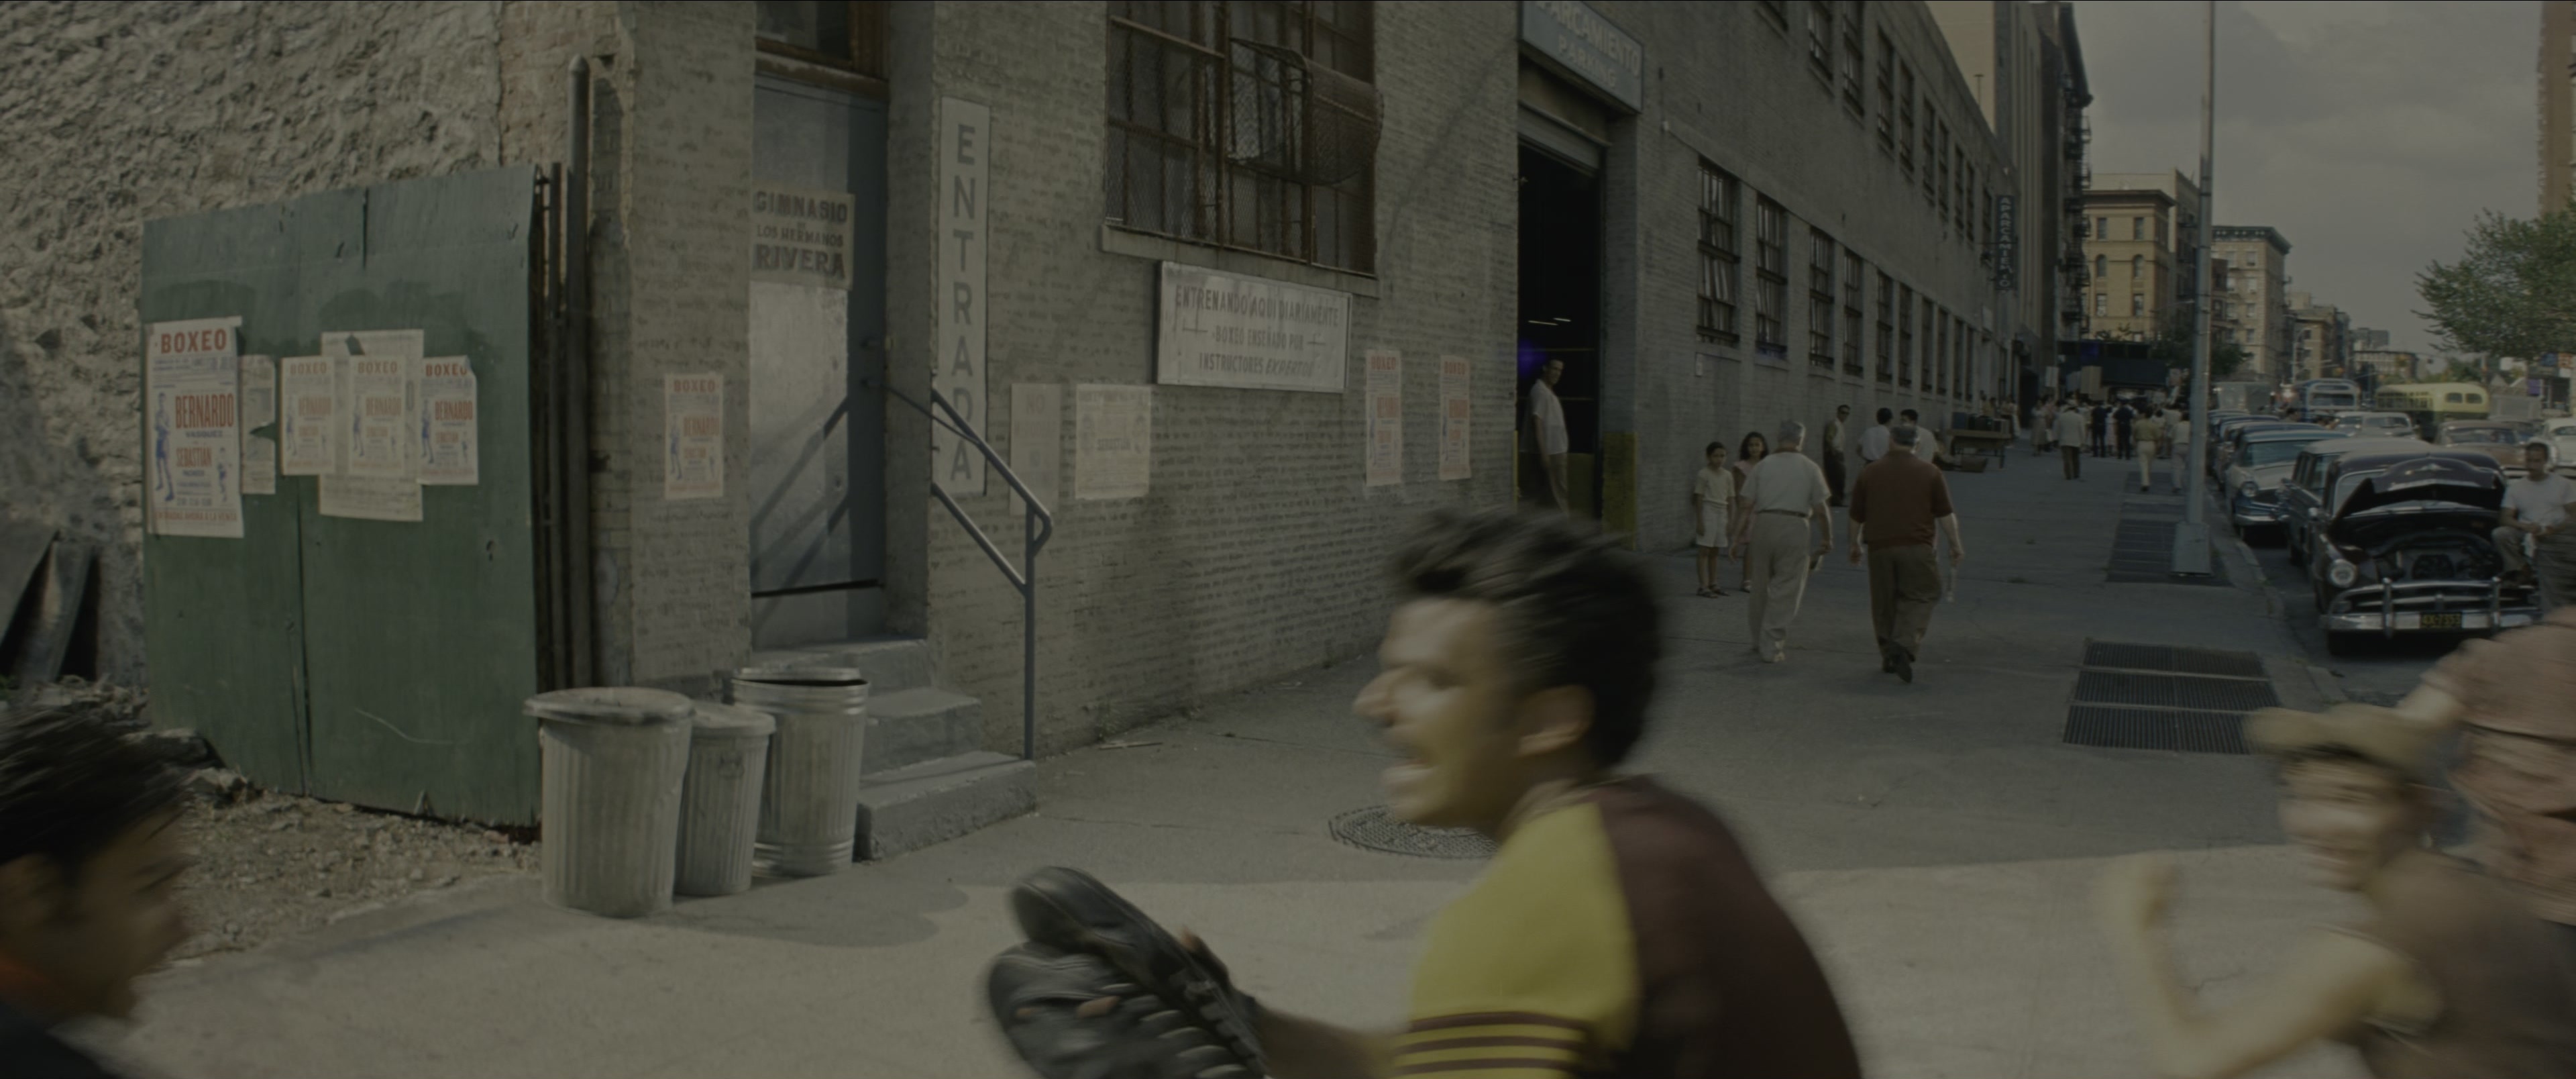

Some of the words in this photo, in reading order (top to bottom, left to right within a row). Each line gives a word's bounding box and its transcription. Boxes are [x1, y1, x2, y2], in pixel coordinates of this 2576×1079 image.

[1535, 1, 1640, 77] ARCAMIENTO
[753, 190, 848, 224] GIMNASIO
[757, 224, 778, 239] LOS
[781, 227, 844, 248] HERMANOS
[751, 243, 846, 280] RIVERA
[950, 123, 977, 481] ENTRADA
[1175, 285, 1248, 316] ENTRENANDO
[1278, 299, 1339, 327] DIARIAMENTE
[160, 328, 227, 354] BOXEO
[1289, 333, 1305, 351] POR
[290, 362, 327, 375] BOXEO
[358, 361, 398, 374] BOXEO
[425, 363, 468, 377] BOXEO
[1199, 352, 1264, 374] INSTRUCTORES
[1265, 356, 1315, 378] EXPERTOS
[1371, 356, 1397, 370] BOXEO
[674, 379, 716, 393] BOXEO
[175, 393, 234, 429] BERNARDO
[365, 397, 402, 417] BERNARDO
[434, 400, 474, 421] BERNARDO
